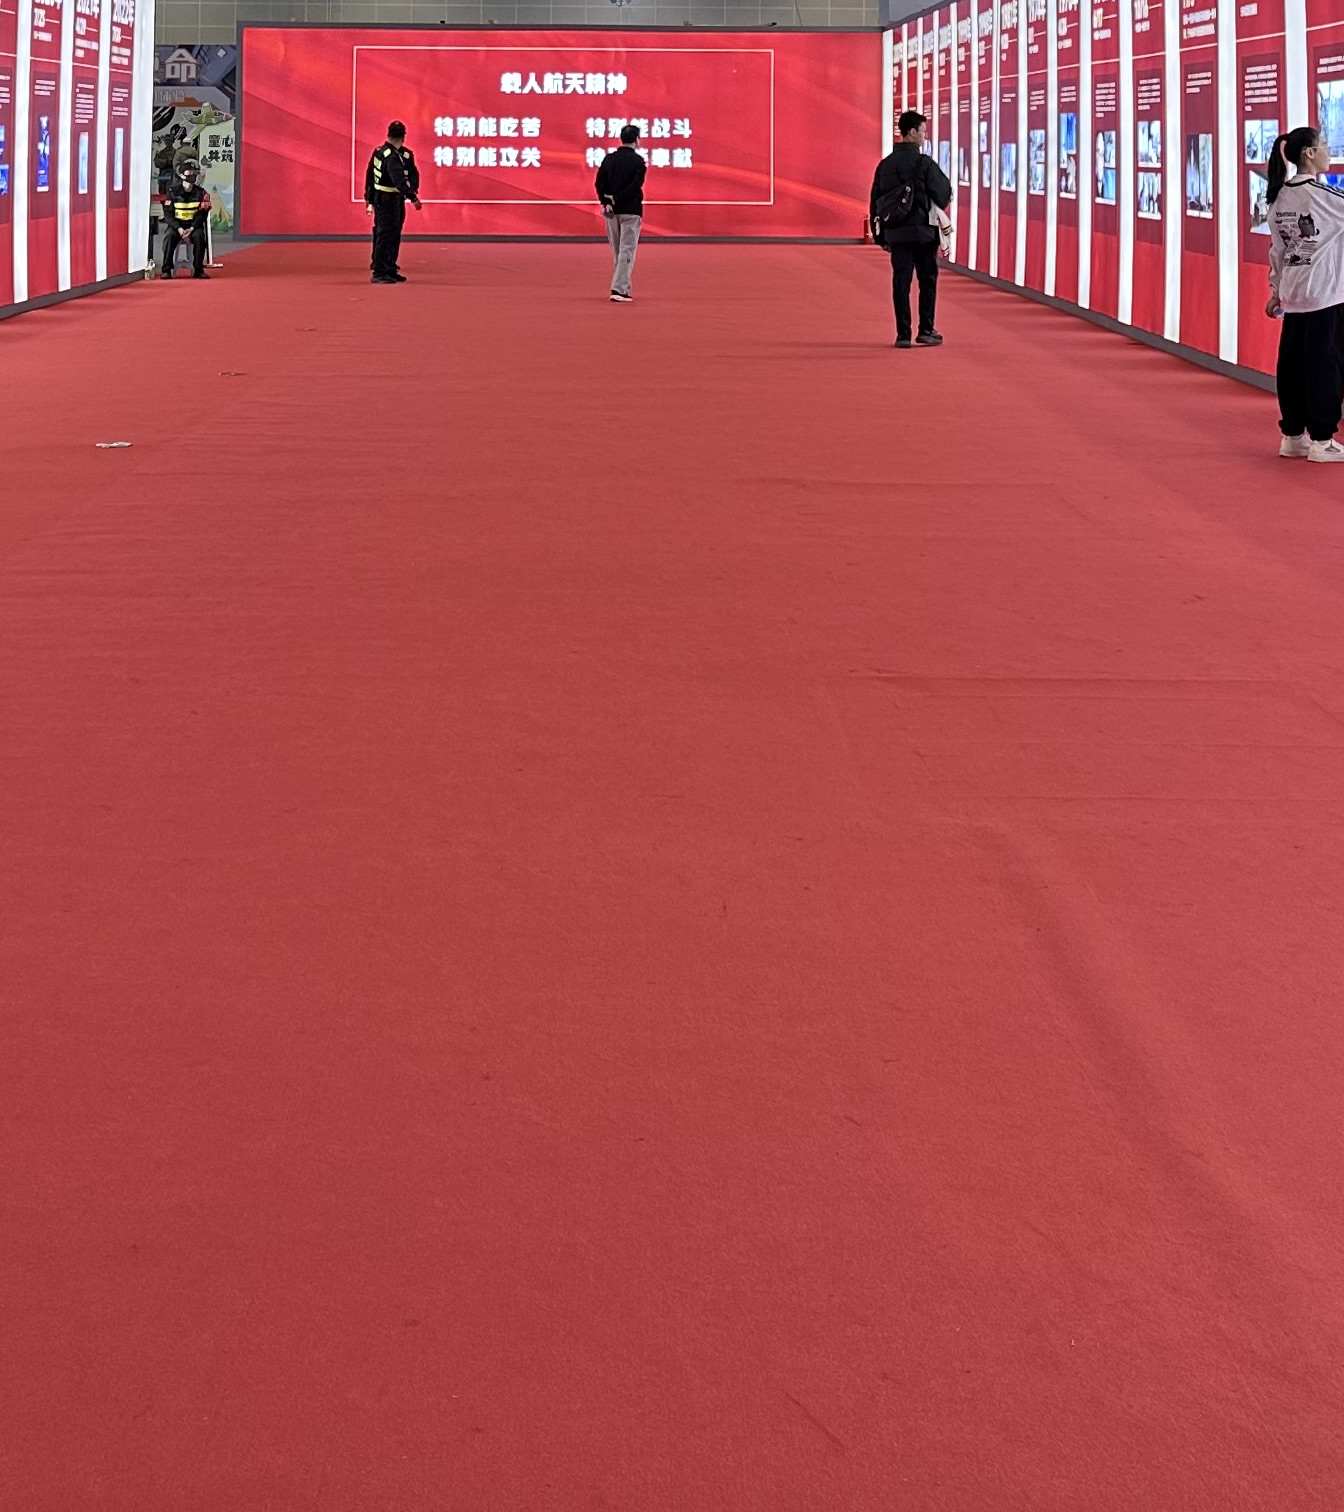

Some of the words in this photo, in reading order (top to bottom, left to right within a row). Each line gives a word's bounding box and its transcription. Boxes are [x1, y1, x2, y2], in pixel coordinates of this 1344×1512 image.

[500, 72, 627, 94] 载人航天精神
[434, 117, 541, 137] 特别能吃苦
[434, 147, 541, 167] 特别能攻关
